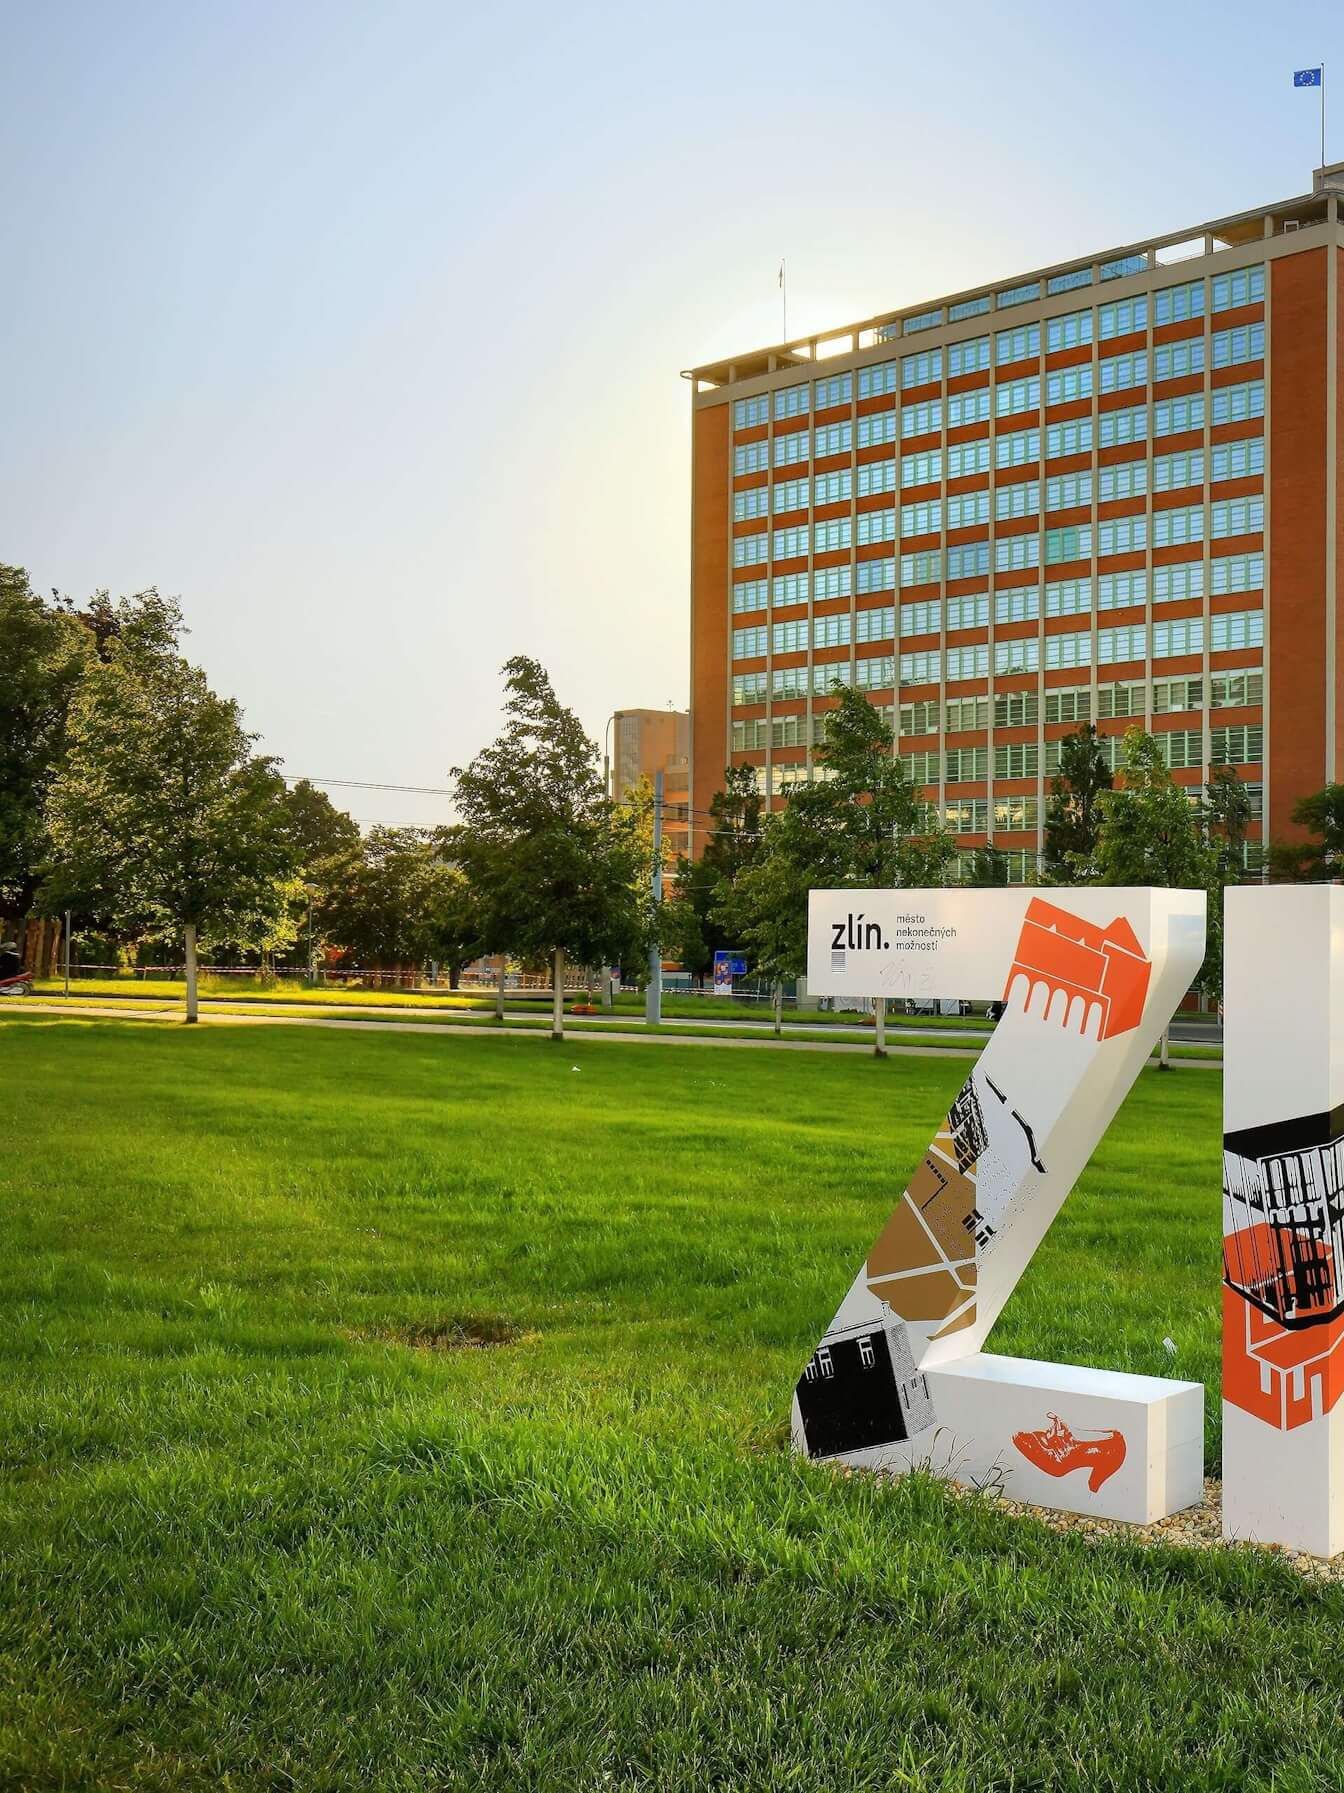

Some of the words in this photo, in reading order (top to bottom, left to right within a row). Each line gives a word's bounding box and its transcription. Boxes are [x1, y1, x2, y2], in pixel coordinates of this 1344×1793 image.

[896, 914, 925, 924] město
[831, 913, 890, 950] zlín.
[896, 927, 957, 939] nekonečných
[896, 940, 938, 951] možností
